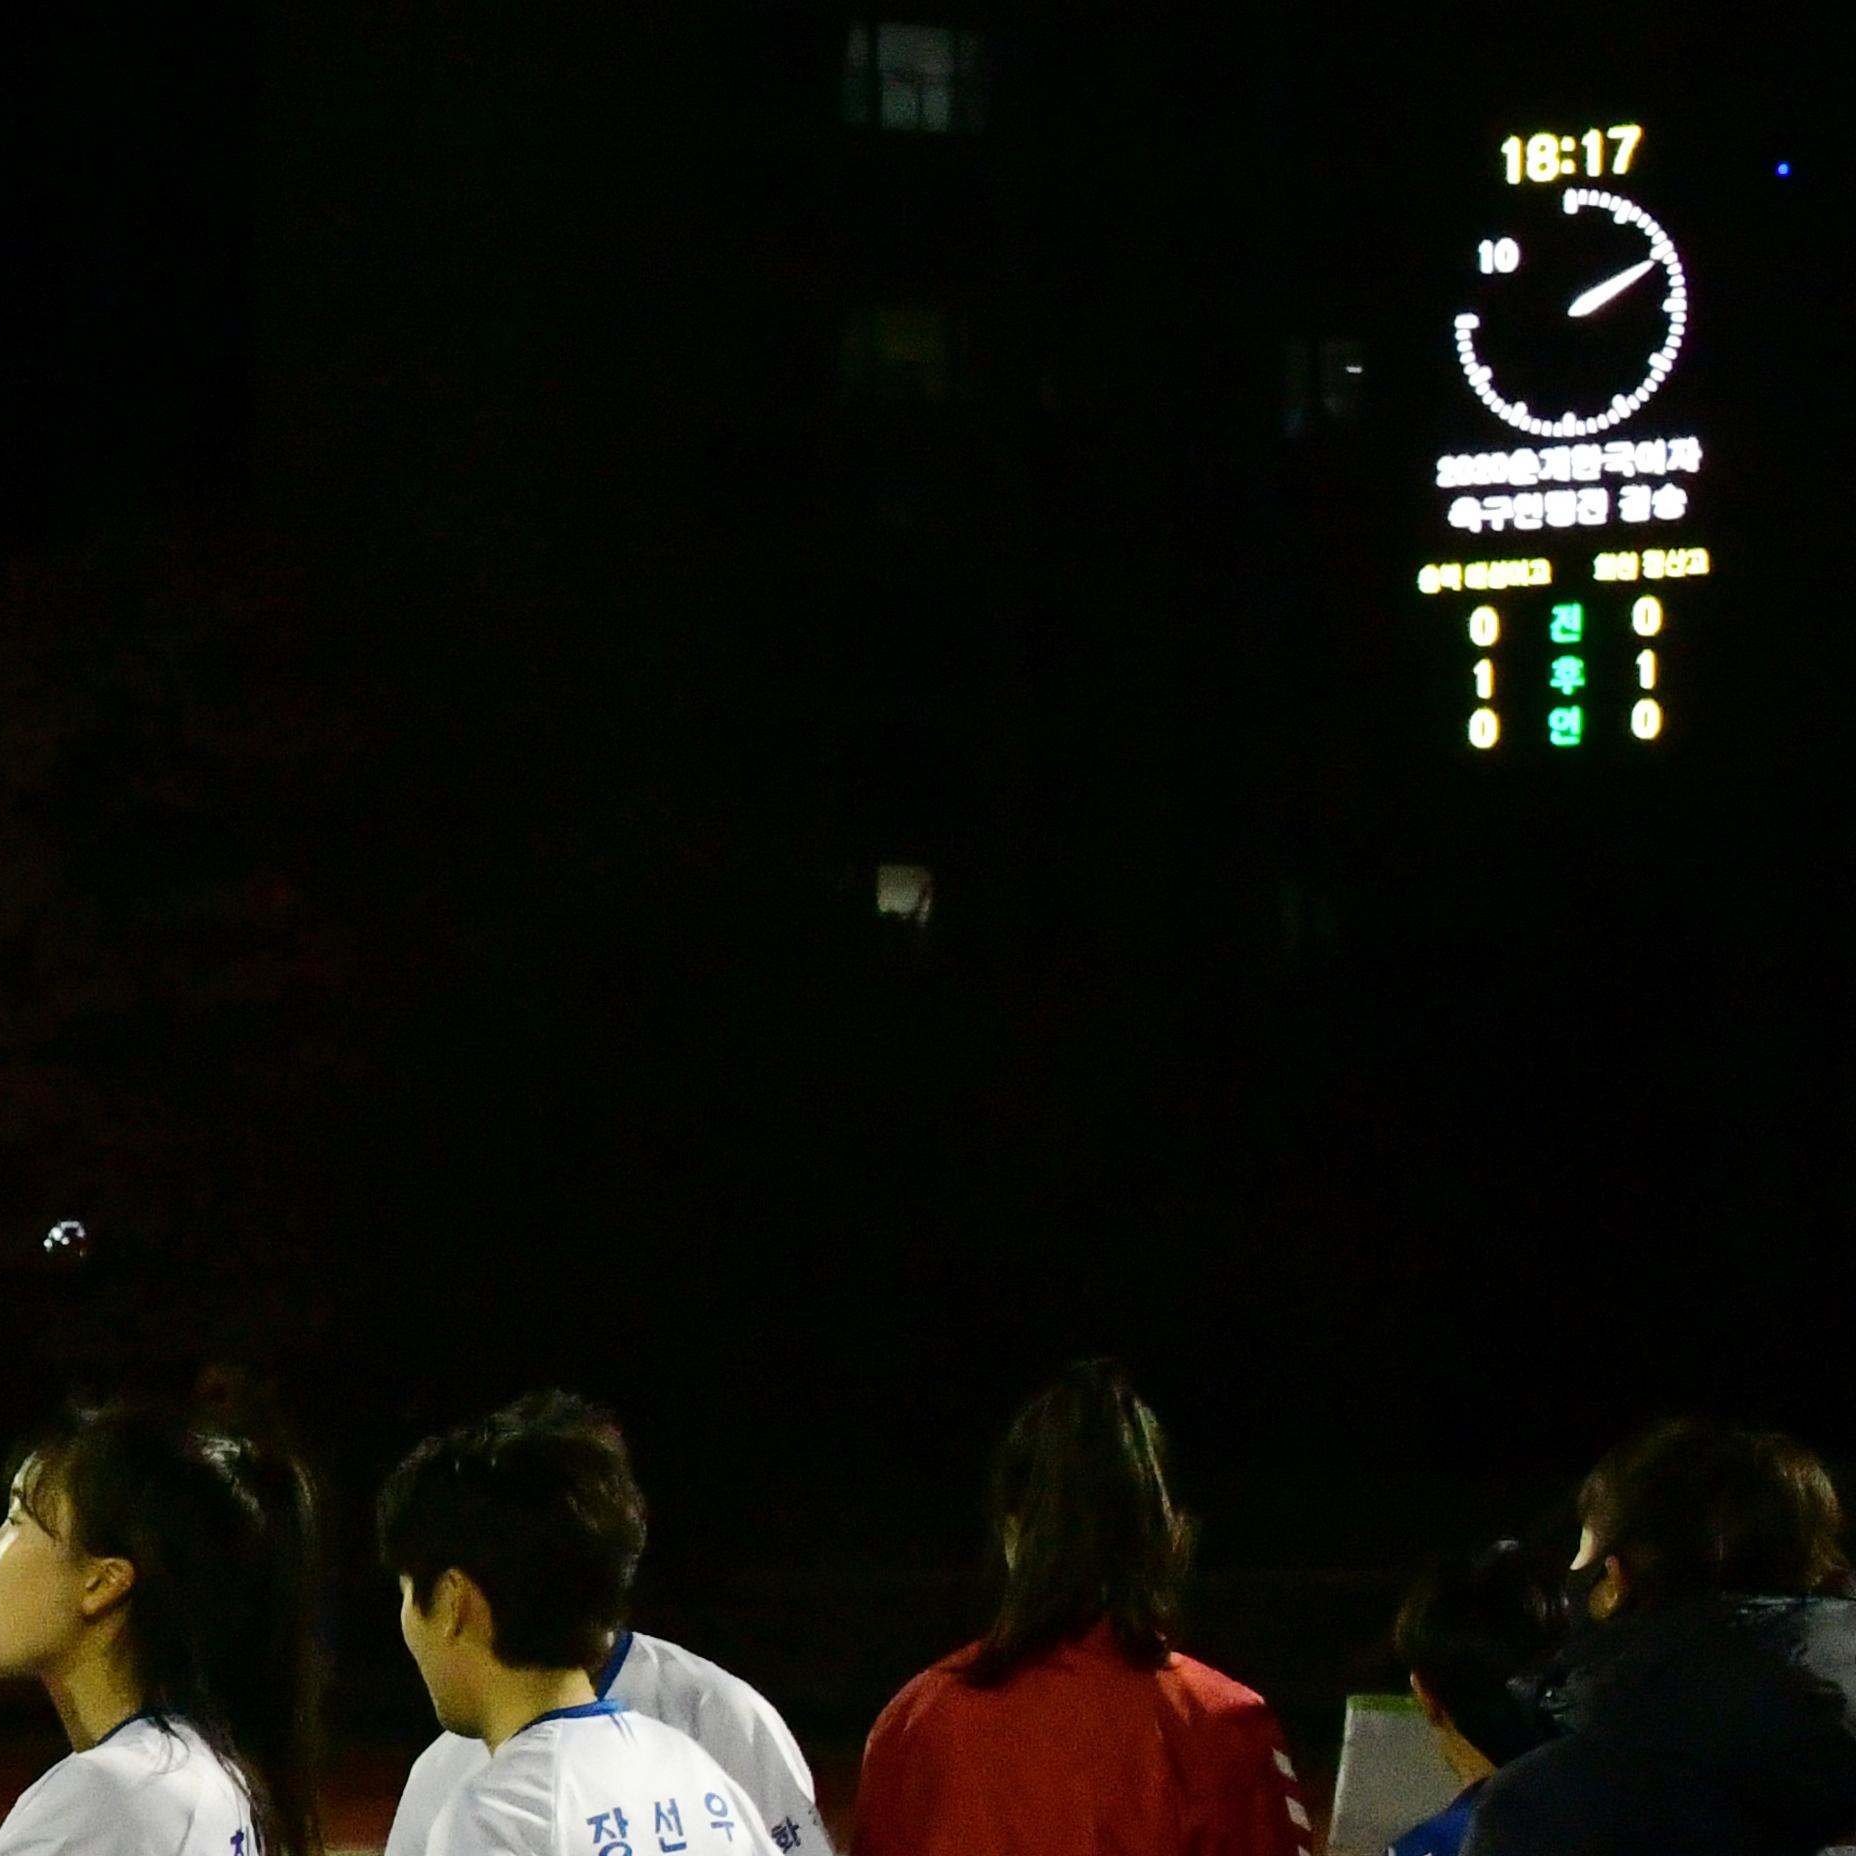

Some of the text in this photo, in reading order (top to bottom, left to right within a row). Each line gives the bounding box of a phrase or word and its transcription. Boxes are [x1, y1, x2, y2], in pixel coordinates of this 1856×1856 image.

[1501, 125, 1642, 184] 18:17
[1478, 238, 1520, 274] 10
[1468, 595, 1663, 647] 0 전 0
[1473, 649, 1657, 700] 1 후 1
[1468, 707, 1500, 749] 0
[1630, 698, 1663, 740] 0
